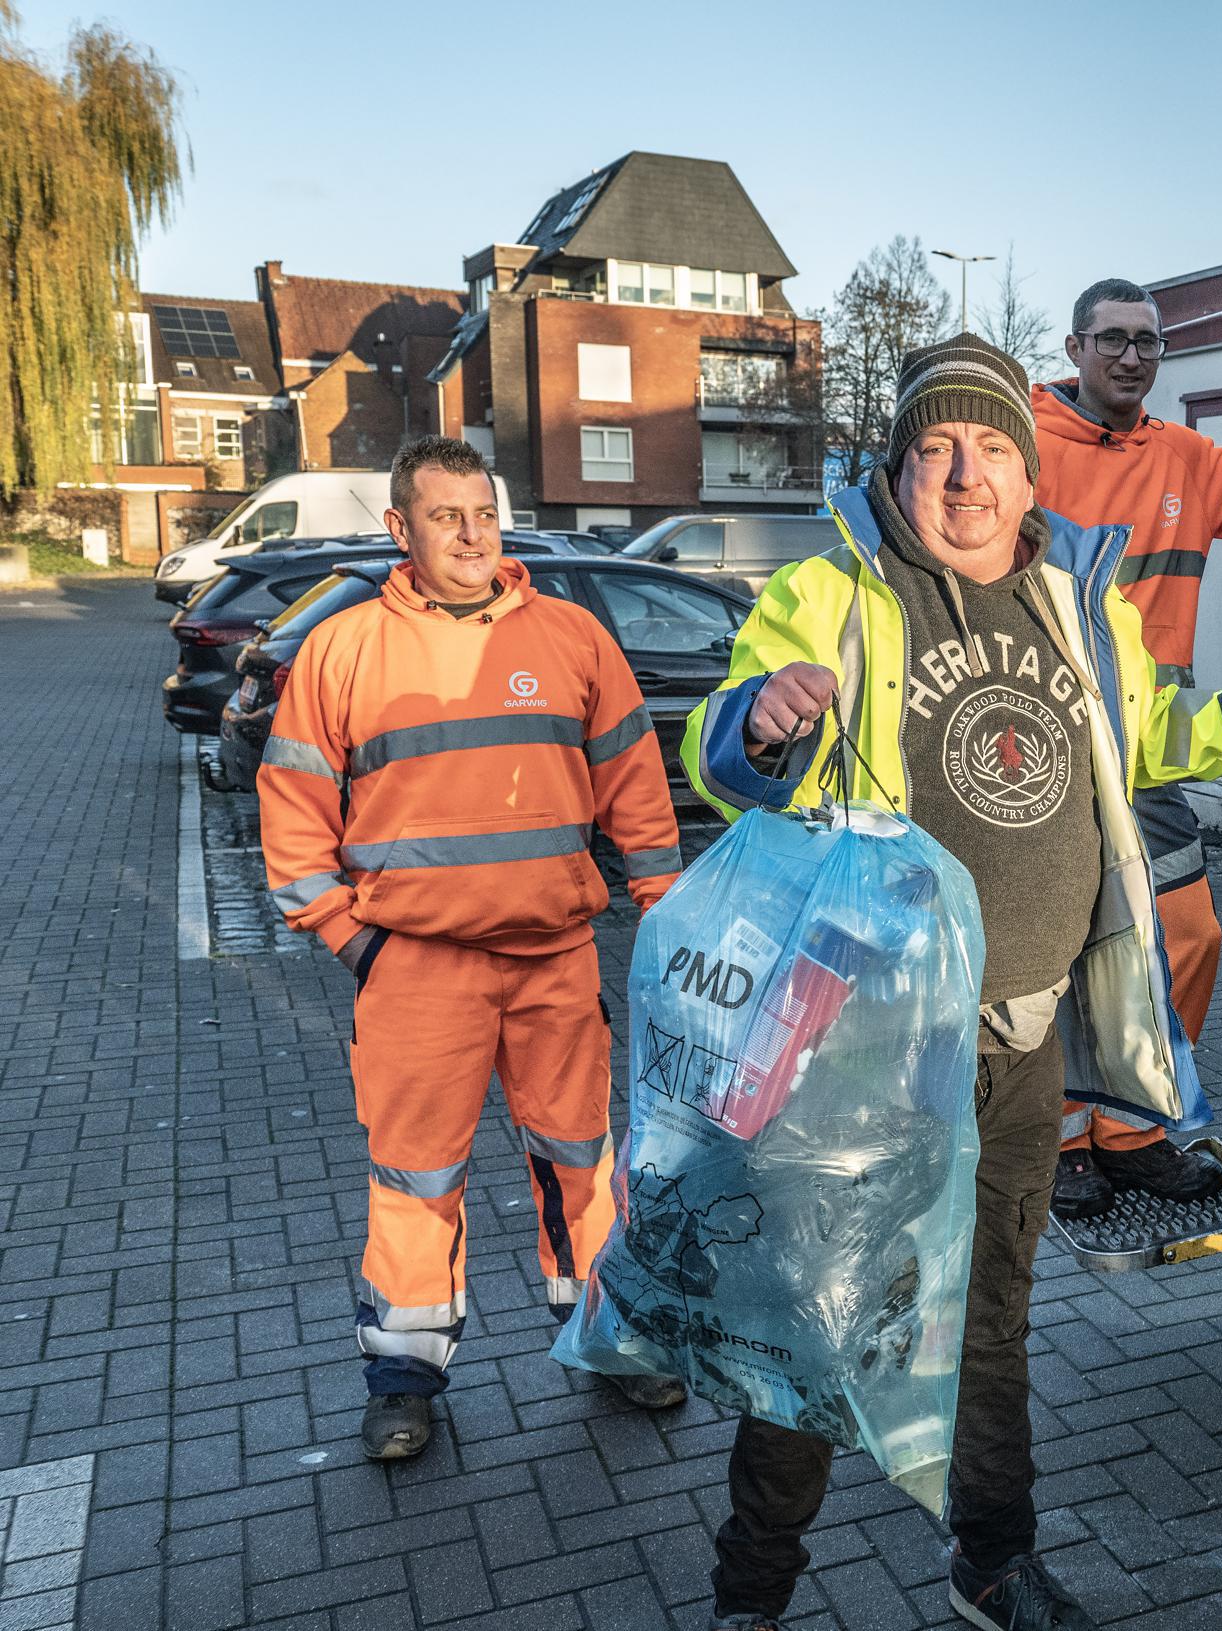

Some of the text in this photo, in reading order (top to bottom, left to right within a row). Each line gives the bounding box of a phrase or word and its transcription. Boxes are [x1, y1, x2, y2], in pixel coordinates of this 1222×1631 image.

[504, 699, 548, 708] GARWIG
[907, 631, 1089, 726] HERITAGE
[953, 693, 1064, 742] OAKWOOD POLO TEAM
[949, 750, 1067, 820] ROYAL COUNTRY CHAMPIONS
[660, 946, 754, 1010] PMD
